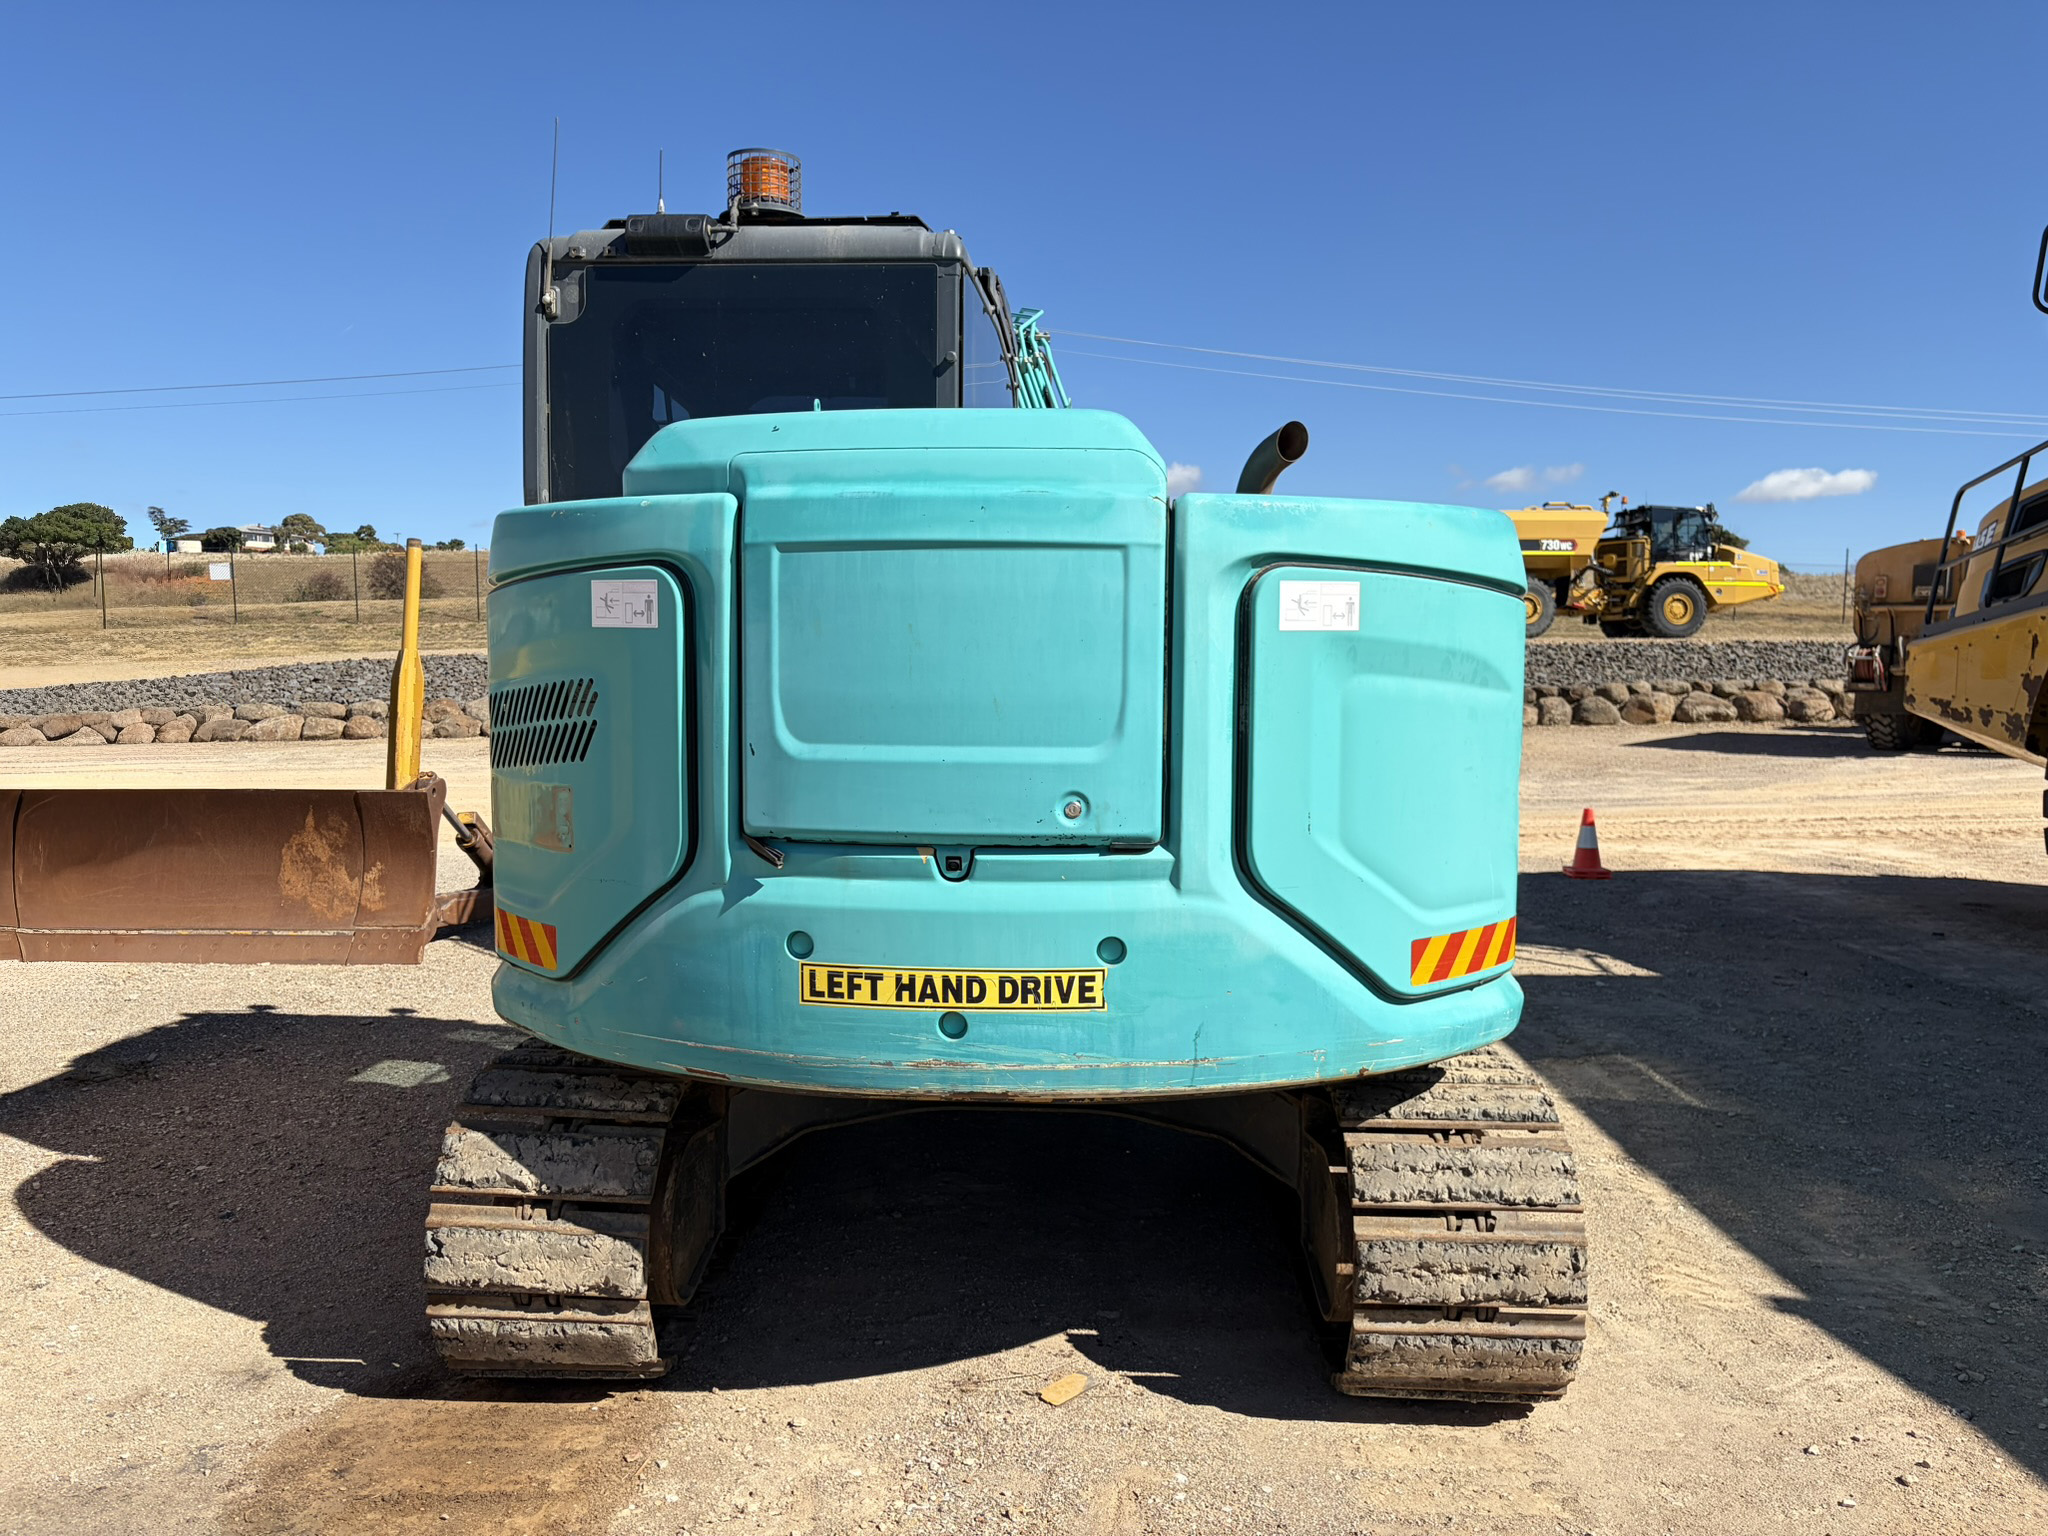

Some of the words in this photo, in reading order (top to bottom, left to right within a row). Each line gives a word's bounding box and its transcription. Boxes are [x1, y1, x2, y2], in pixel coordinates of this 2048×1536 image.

[809, 969, 884, 1001] LEFT
[895, 973, 987, 1004] HAND
[998, 975, 1097, 1004] DRIVE
